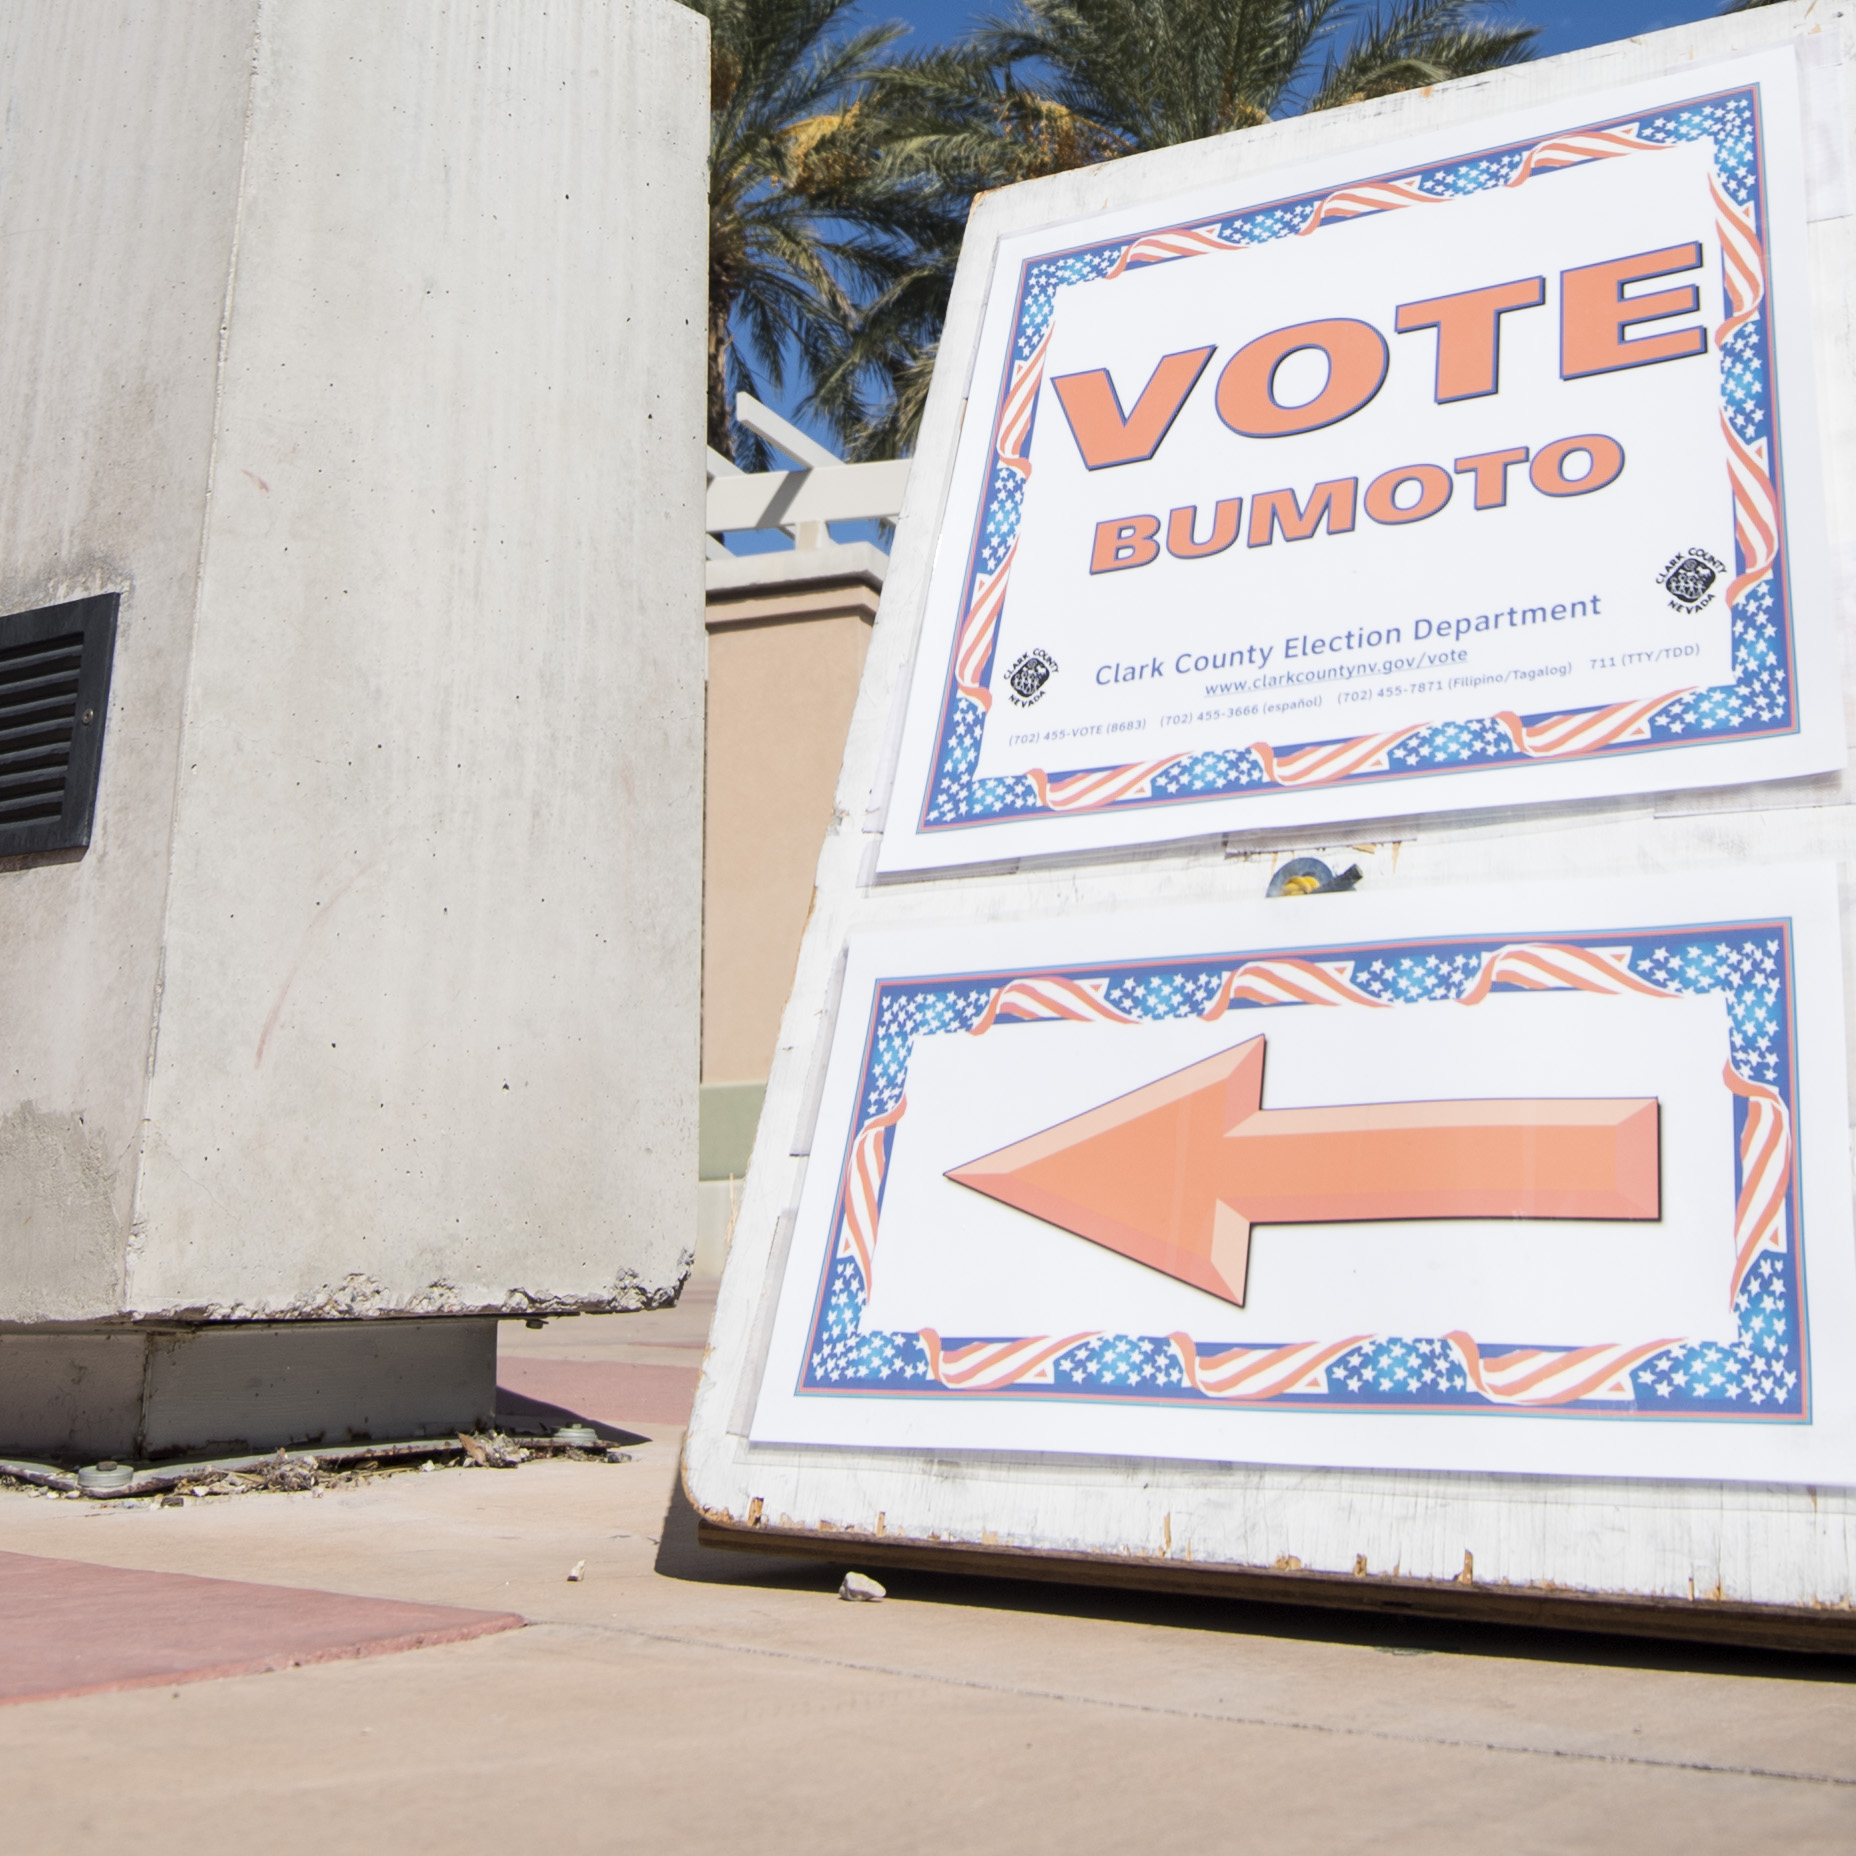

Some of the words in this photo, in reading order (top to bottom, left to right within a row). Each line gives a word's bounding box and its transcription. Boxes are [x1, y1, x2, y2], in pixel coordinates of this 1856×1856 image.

[1050, 240, 1707, 470] VOTE
[1089, 433, 1625, 575] BUMOTO
[1655, 552, 1685, 584] CLARK
[1688, 547, 1727, 574] COUNTY
[1667, 593, 1716, 615] NEVADA
[1095, 657, 1164, 686] Clark
[1175, 644, 1274, 675] County
[1284, 627, 1402, 659] Election
[1414, 594, 1601, 642] Department
[1003, 651, 1029, 680] CLARK
[1204, 649, 1468, 696] www.clarkcountynv.gov/vote
[1009, 733, 1040, 747] (702)
[1043, 724, 1103, 741] 455-VOTE
[1106, 718, 1147, 735] (8683)
[1160, 712, 1193, 728] (702)
[1197, 704, 1259, 722] 455-3666
[1262, 695, 1323, 715] (español)
[1337, 689, 1373, 705] (702)
[1377, 680, 1443, 698] 455-7871
[1448, 661, 1572, 690] (Filipino/Tagalog)
[1590, 657, 1617, 670] 711
[1621, 643, 1701, 667] (TTY/TDD)
[1009, 690, 1046, 708] NEVADA
